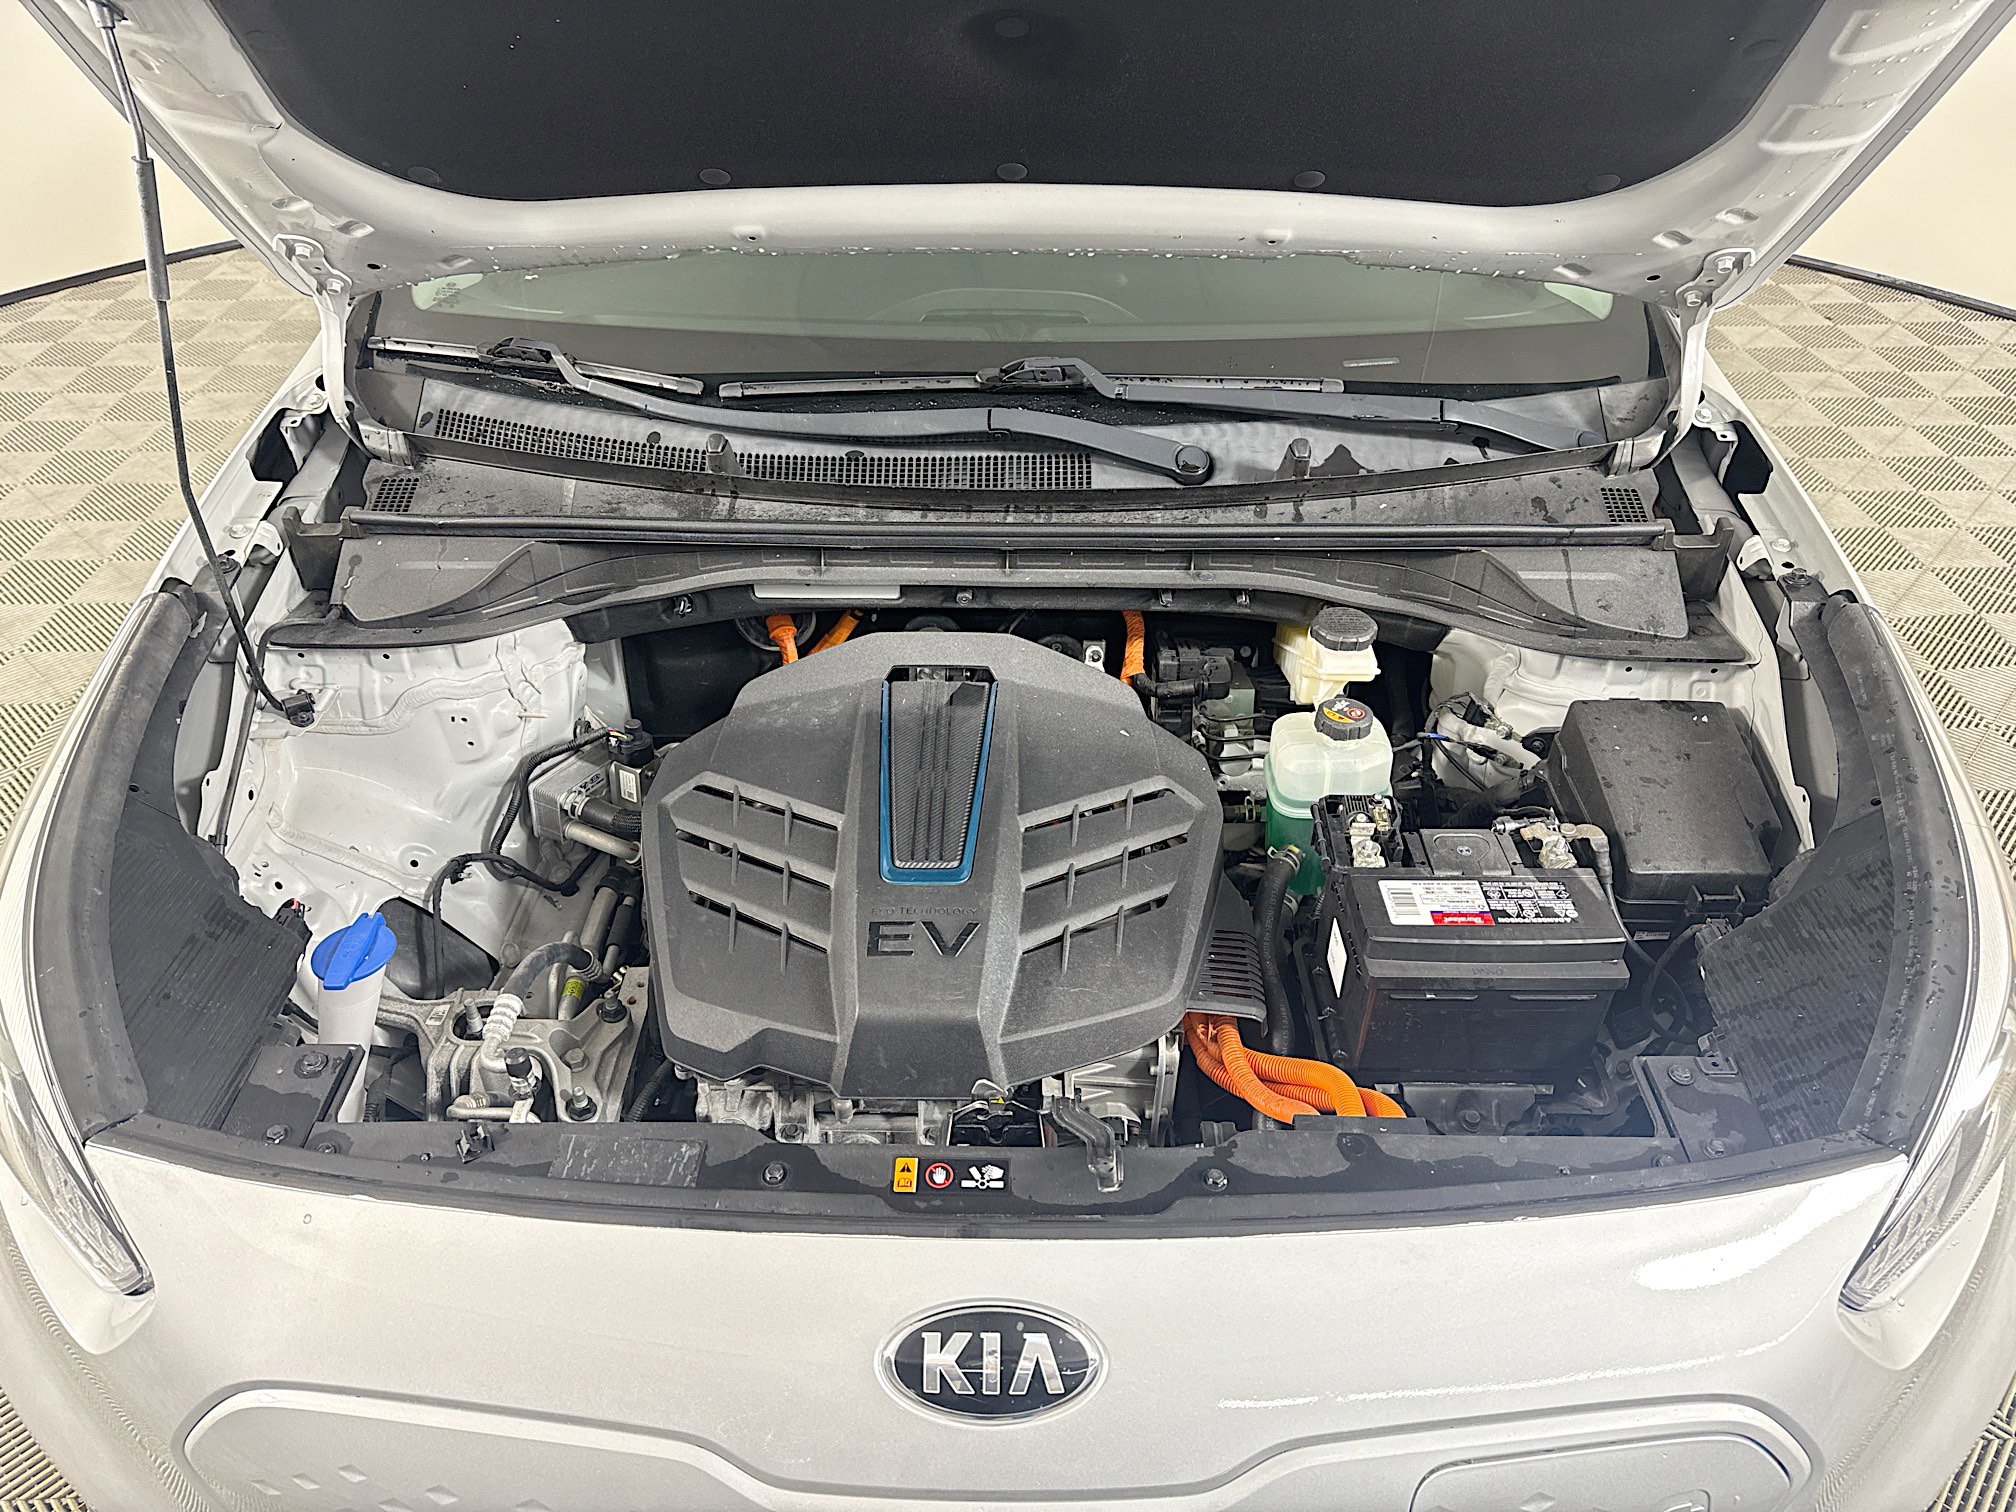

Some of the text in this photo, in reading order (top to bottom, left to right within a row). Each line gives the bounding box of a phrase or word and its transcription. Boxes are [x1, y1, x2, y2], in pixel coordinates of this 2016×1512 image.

[900, 906, 978, 915] TECHNOLOGY
[1443, 916, 1484, 924] Duralast
[866, 920, 981, 957] EV
[921, 1331, 1065, 1396] KIA
